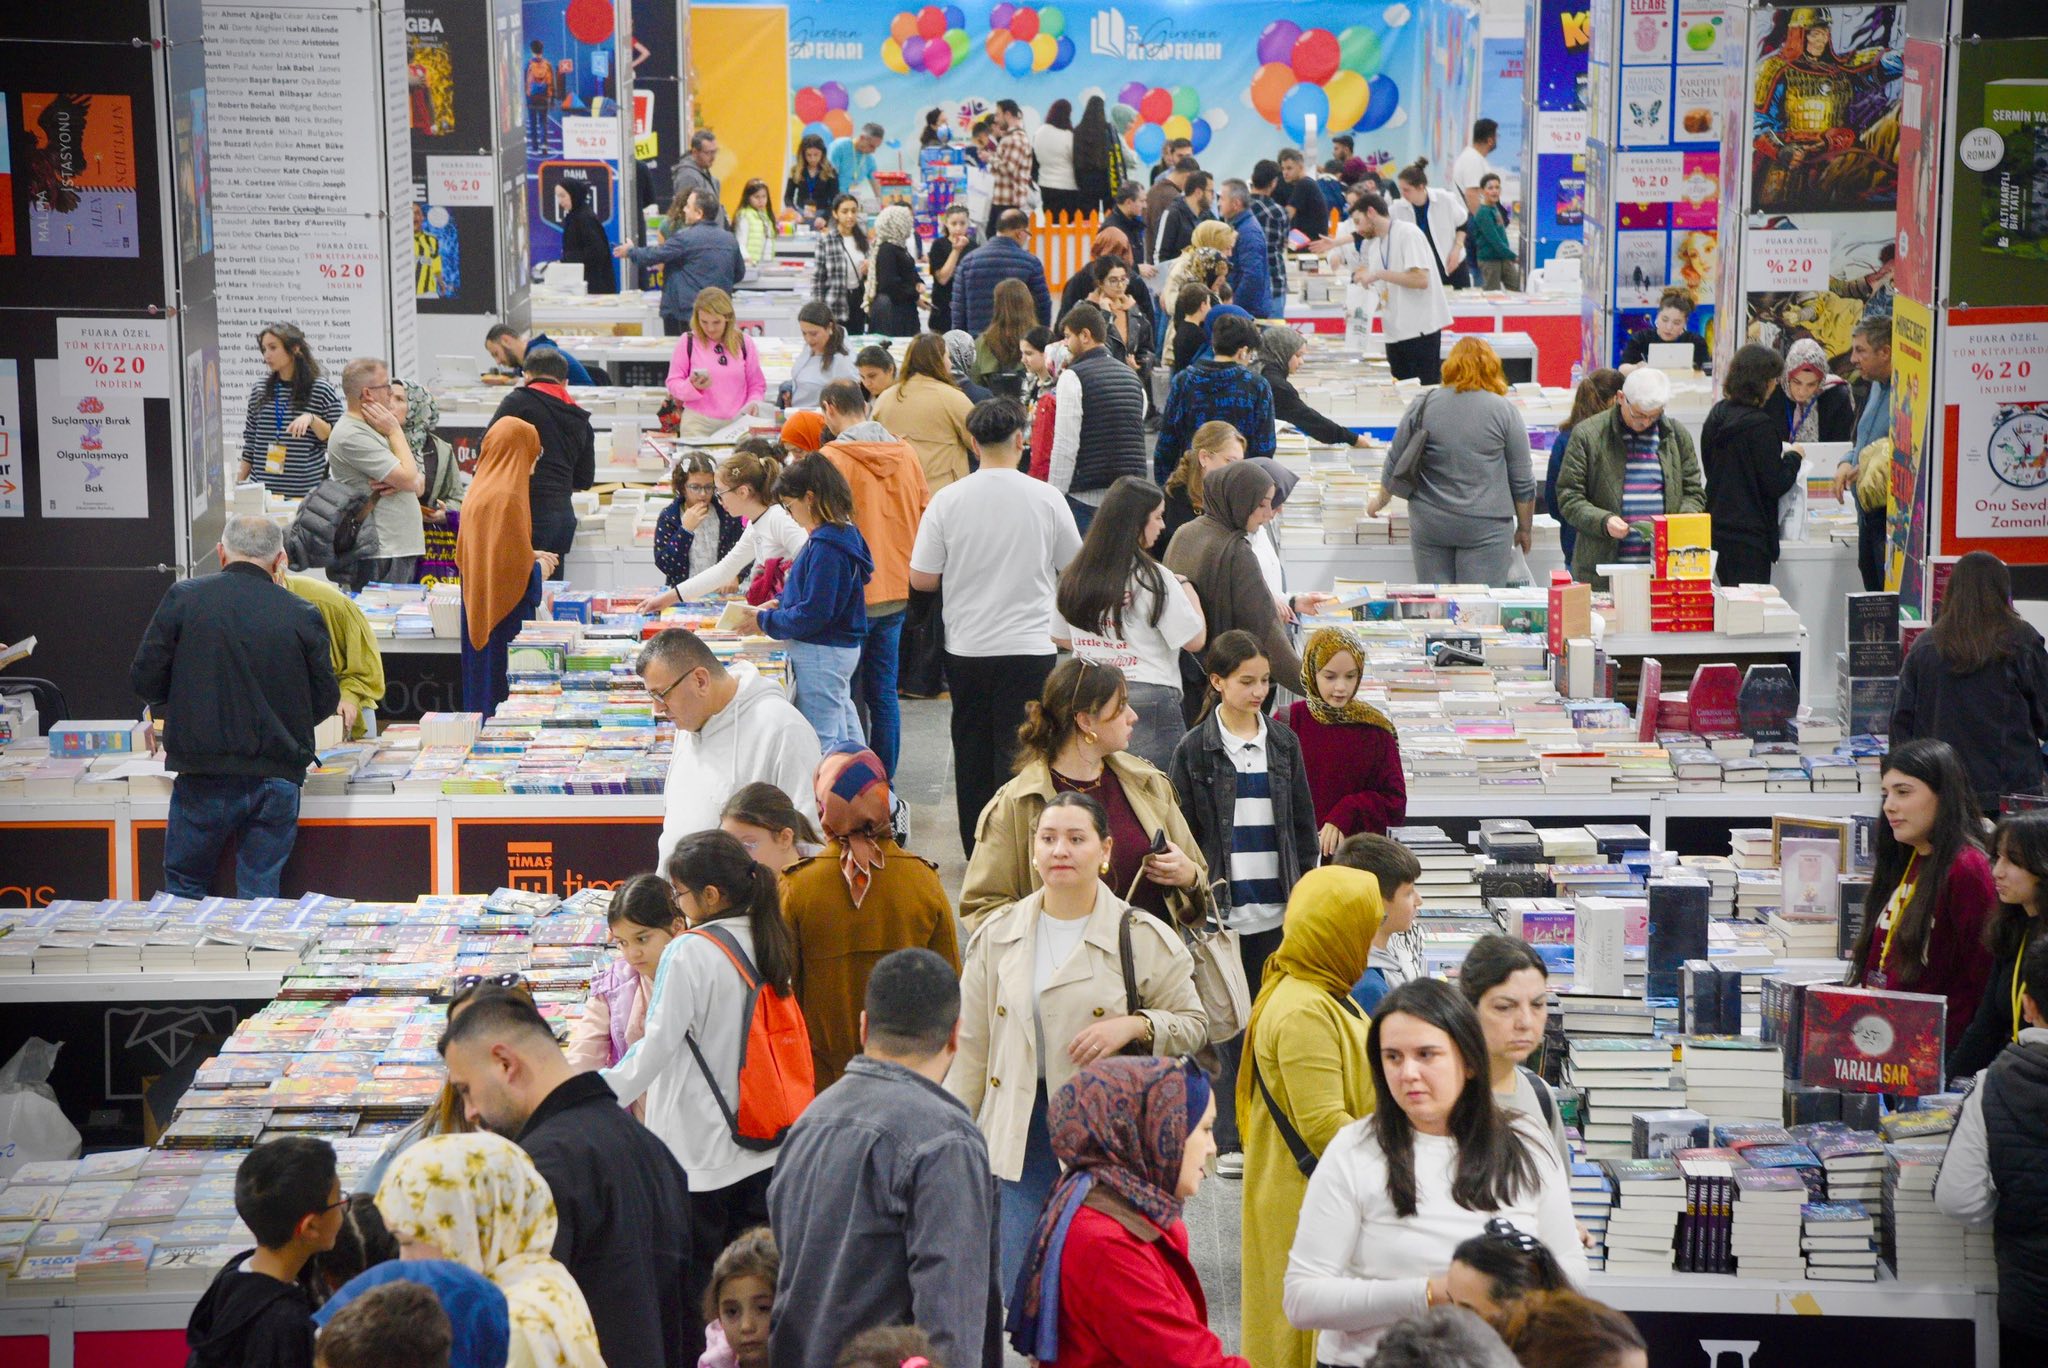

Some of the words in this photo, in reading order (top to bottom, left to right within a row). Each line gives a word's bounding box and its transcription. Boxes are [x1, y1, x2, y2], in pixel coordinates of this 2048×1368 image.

[318, 52, 340, 60] Yusuf
[280, 90, 312, 99] Bilbaşar
[218, 102, 248, 110] Roberto
[1993, 108, 2031, 123] ŞERMİN
[314, 118, 343, 126] Bradley
[325, 142, 344, 150] Büke
[1973, 135, 1992, 146] YENİ
[1966, 150, 1996, 161] ROMAN
[302, 168, 329, 176] Chopin
[322, 181, 346, 189] Joseph
[2010, 186, 2020, 212] TATLI
[274, 219, 300, 227] Barbey
[304, 219, 346, 227] d'Aurevilly
[2000, 207, 2010, 229] ALTI
[2010, 214, 2019, 230] BİR
[348, 242, 369, 250] ÖZEL
[320, 264, 365, 278] %20
[1767, 258, 1812, 273] %20
[259, 307, 292, 315] Esquivel
[82, 329, 117, 338] FUARA
[122, 328, 151, 338] ÖZEL
[1970, 334, 2006, 344] FUARA
[2010, 332, 2039, 342] ÖZEL
[64, 341, 88, 350] TÜM
[94, 341, 165, 351] KİTAPLARDA
[1952, 348, 1976, 358] TÜM
[85, 356, 145, 375] %20
[1972, 360, 2031, 381] %20
[95, 379, 144, 389] İNDİRİM
[1980, 384, 2027, 395] İNDİRİM
[52, 416, 103, 427] Suçlamayı
[105, 416, 131, 425] Bırak
[57, 451, 129, 462] Olgunlaşmaya
[85, 484, 104, 493] Bak
[1976, 499, 2006, 513] Onu
[2012, 498, 2048, 512] Sevd
[1116, 642, 1128, 650] of
[508, 854, 553, 870] TİMAŞ
[1834, 1058, 1910, 1086] YARALASAR
